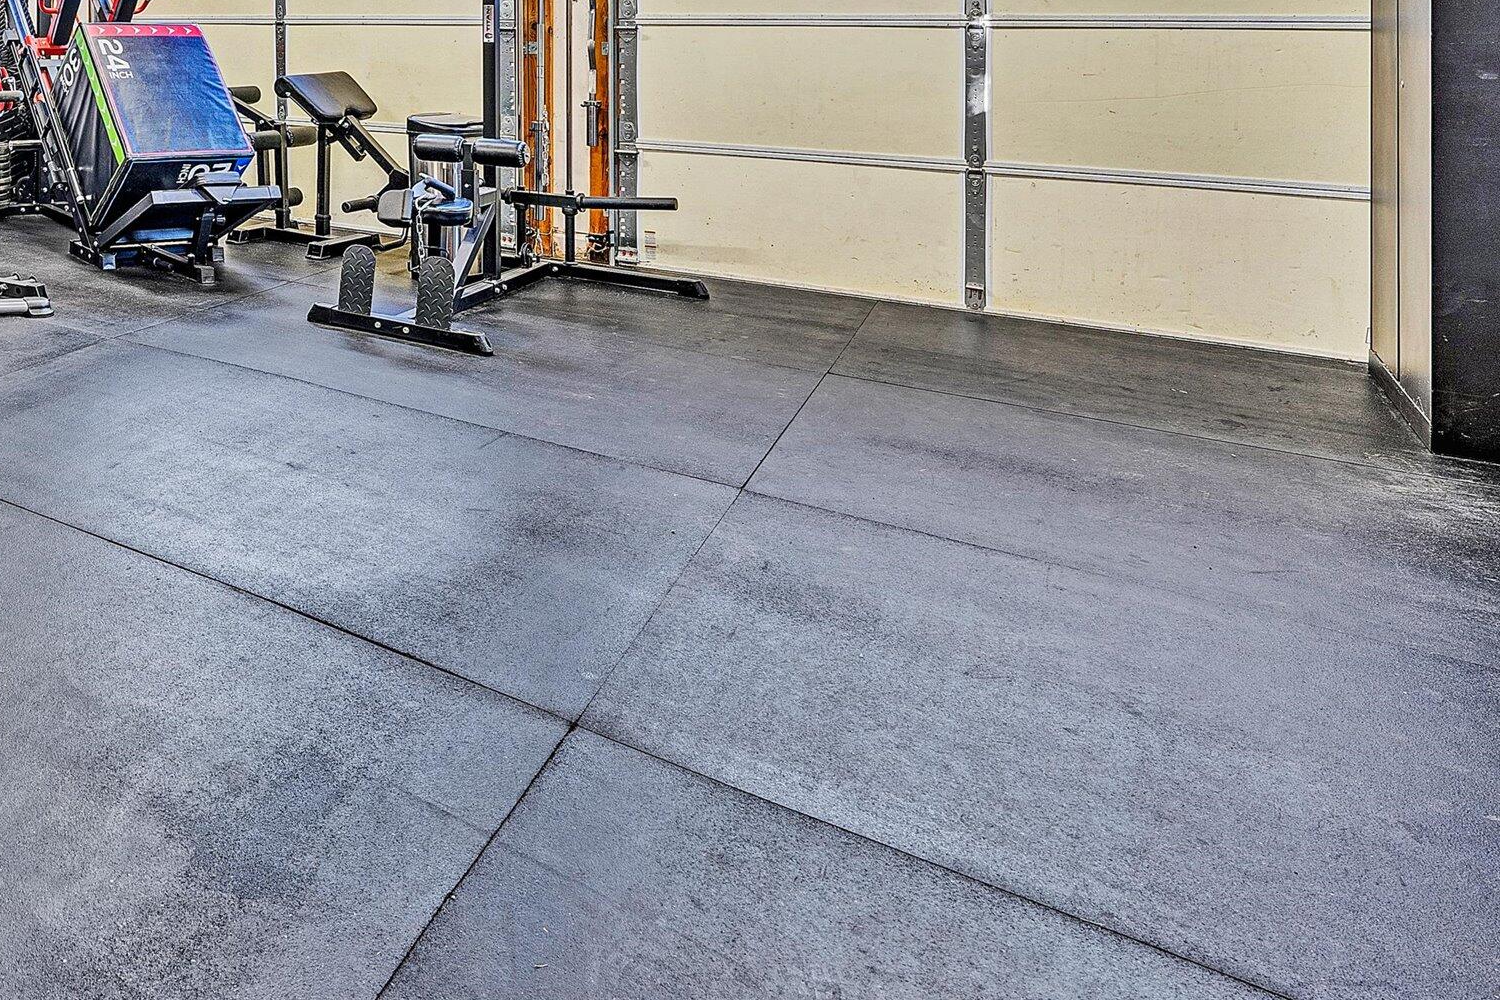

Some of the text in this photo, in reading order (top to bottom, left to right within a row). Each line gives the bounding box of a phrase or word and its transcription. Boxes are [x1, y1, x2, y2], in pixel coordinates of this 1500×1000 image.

[63, 48, 81, 87] 30
[97, 39, 134, 79] 24 INCH
[176, 164, 192, 184] INCH
